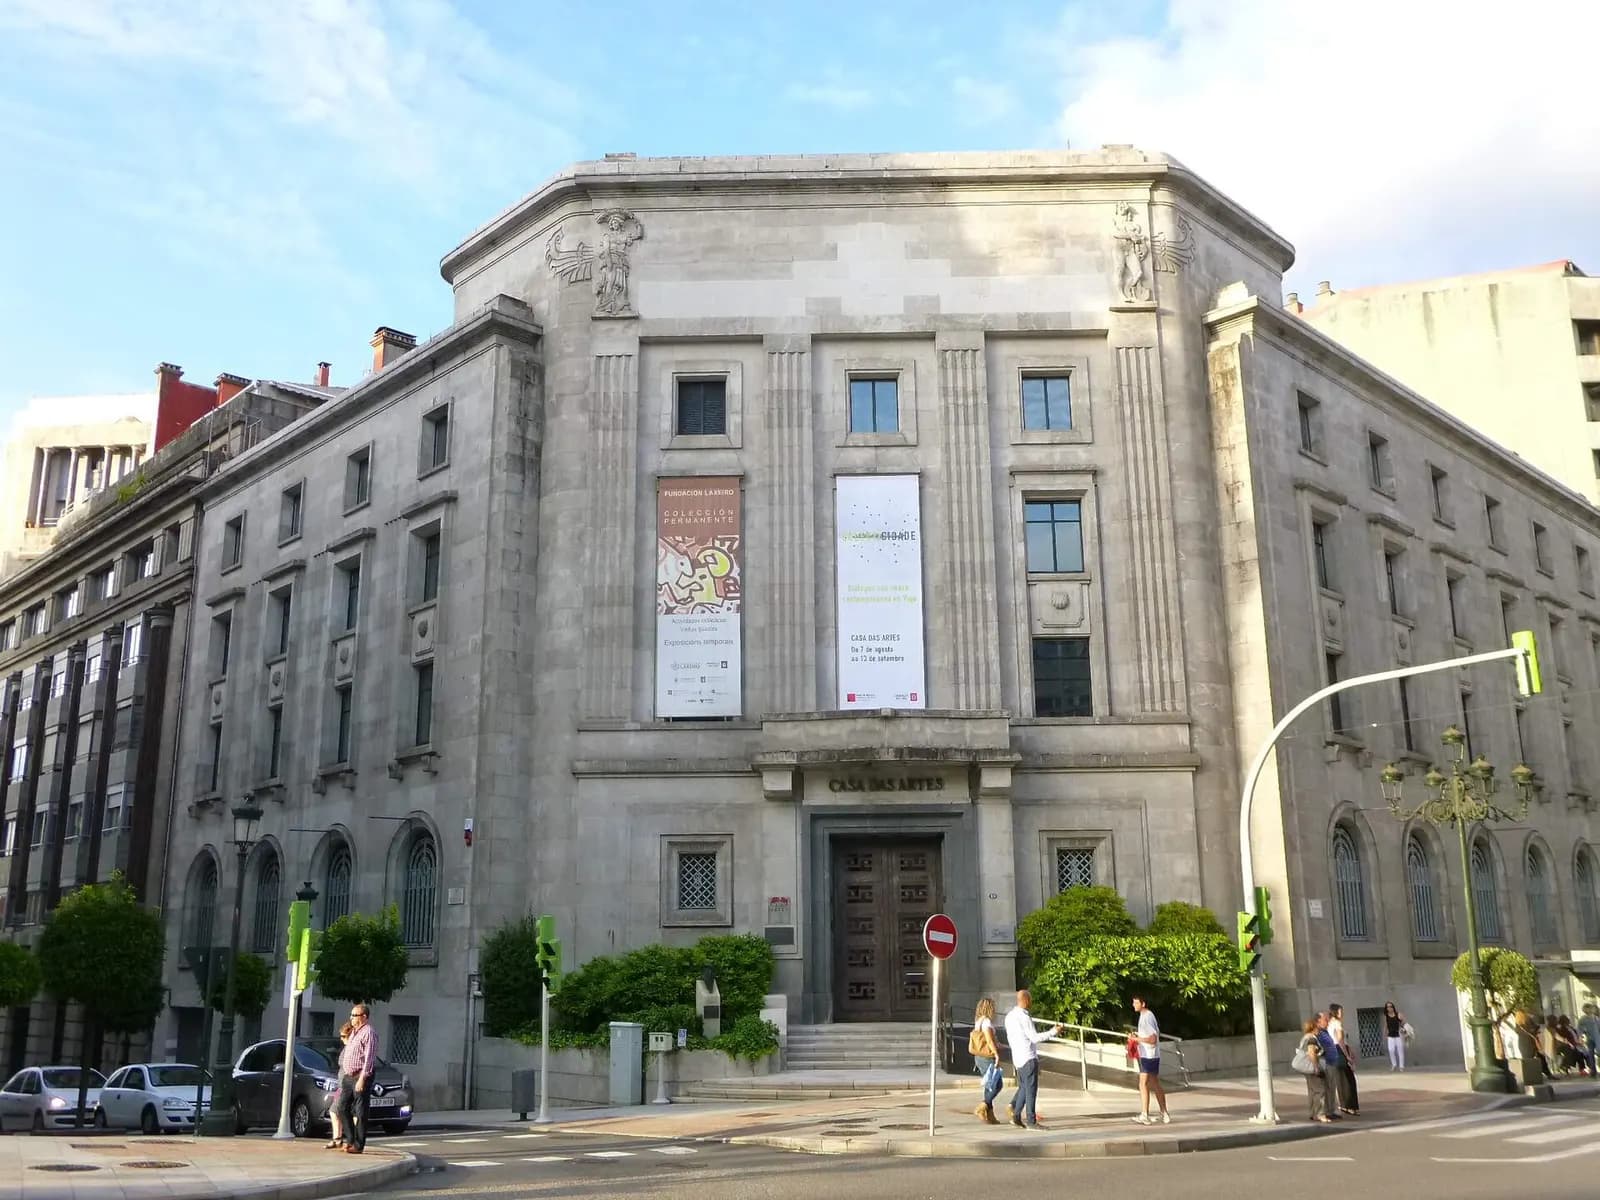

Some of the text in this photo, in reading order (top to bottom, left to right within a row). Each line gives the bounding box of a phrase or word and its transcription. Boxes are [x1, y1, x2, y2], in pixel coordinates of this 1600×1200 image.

[664, 517, 734, 525] PERMANENTE
[882, 633, 901, 641] ARTES
[828, 778, 866, 793] CASA
[898, 777, 944, 791] ARTES
